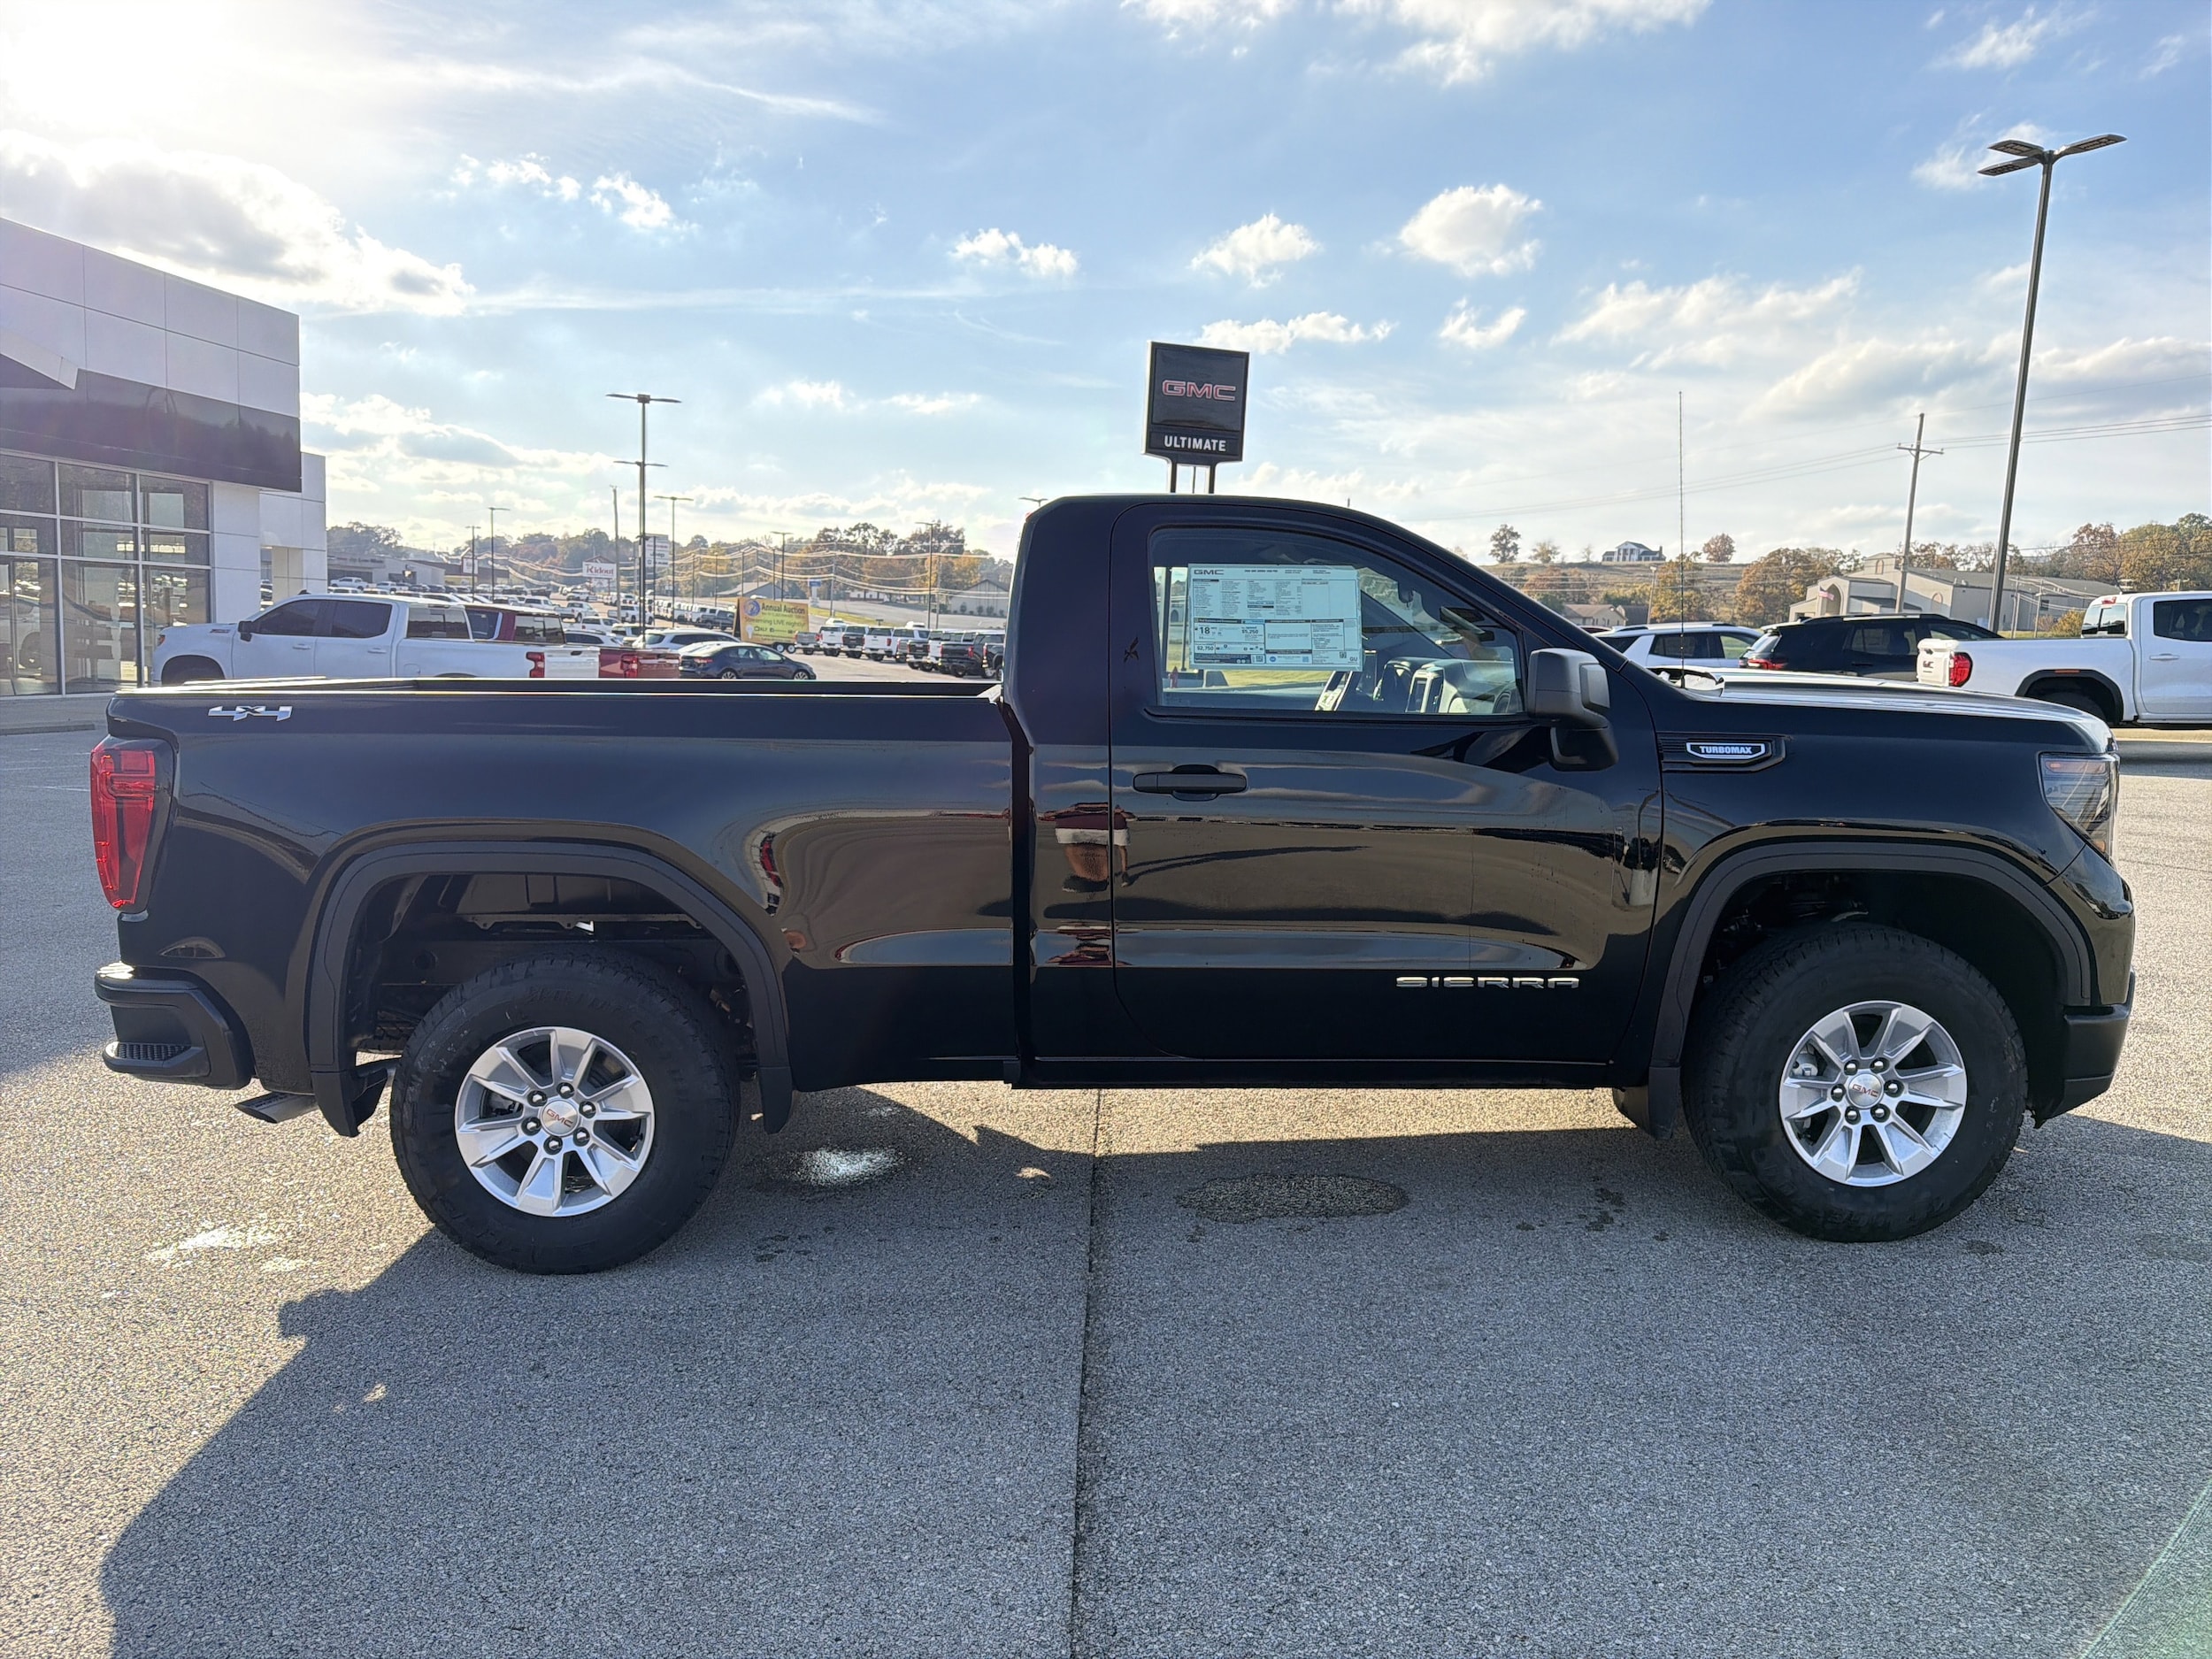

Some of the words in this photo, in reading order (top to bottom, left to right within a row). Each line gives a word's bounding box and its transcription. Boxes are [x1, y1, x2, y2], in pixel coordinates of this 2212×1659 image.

[1162, 380, 1236, 401] GMC
[1164, 435, 1226, 452] ULTIMATE
[761, 603, 782, 612] Annual
[783, 605, 805, 615] Auction
[1396, 976, 1580, 989] SIERRA
[1852, 1083, 1879, 1097] GMC
[546, 1108, 573, 1128] GMC
